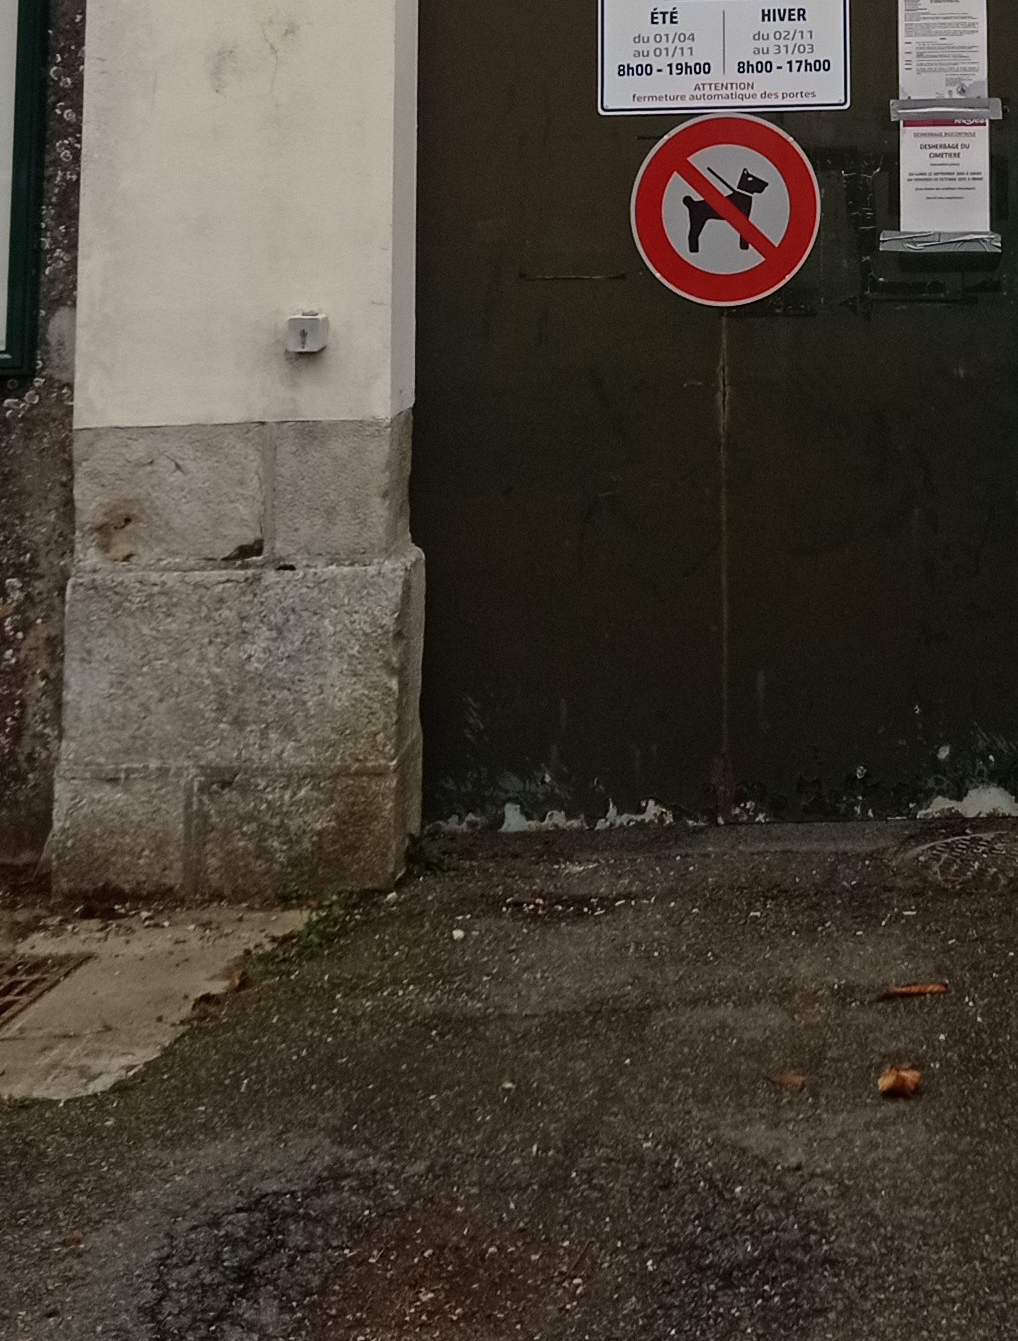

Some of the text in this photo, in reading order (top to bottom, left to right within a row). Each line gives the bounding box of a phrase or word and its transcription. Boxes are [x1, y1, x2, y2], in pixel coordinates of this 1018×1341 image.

[650, 7, 679, 25] ÉTÉ
[761, 7, 807, 23] HIVER
[632, 32, 696, 45] du 01/04
[752, 29, 814, 42] du 02/11
[632, 46, 694, 58] au 01/11
[752, 43, 815, 56] au 31/03
[617, 62, 653, 77] 8h00
[667, 62, 712, 76] 19h00
[737, 60, 773, 74] 8h00
[786, 59, 831, 73] 17h00
[693, 82, 755, 92] ATTENTION
[632, 89, 817, 103] fermeture automatique des portes
